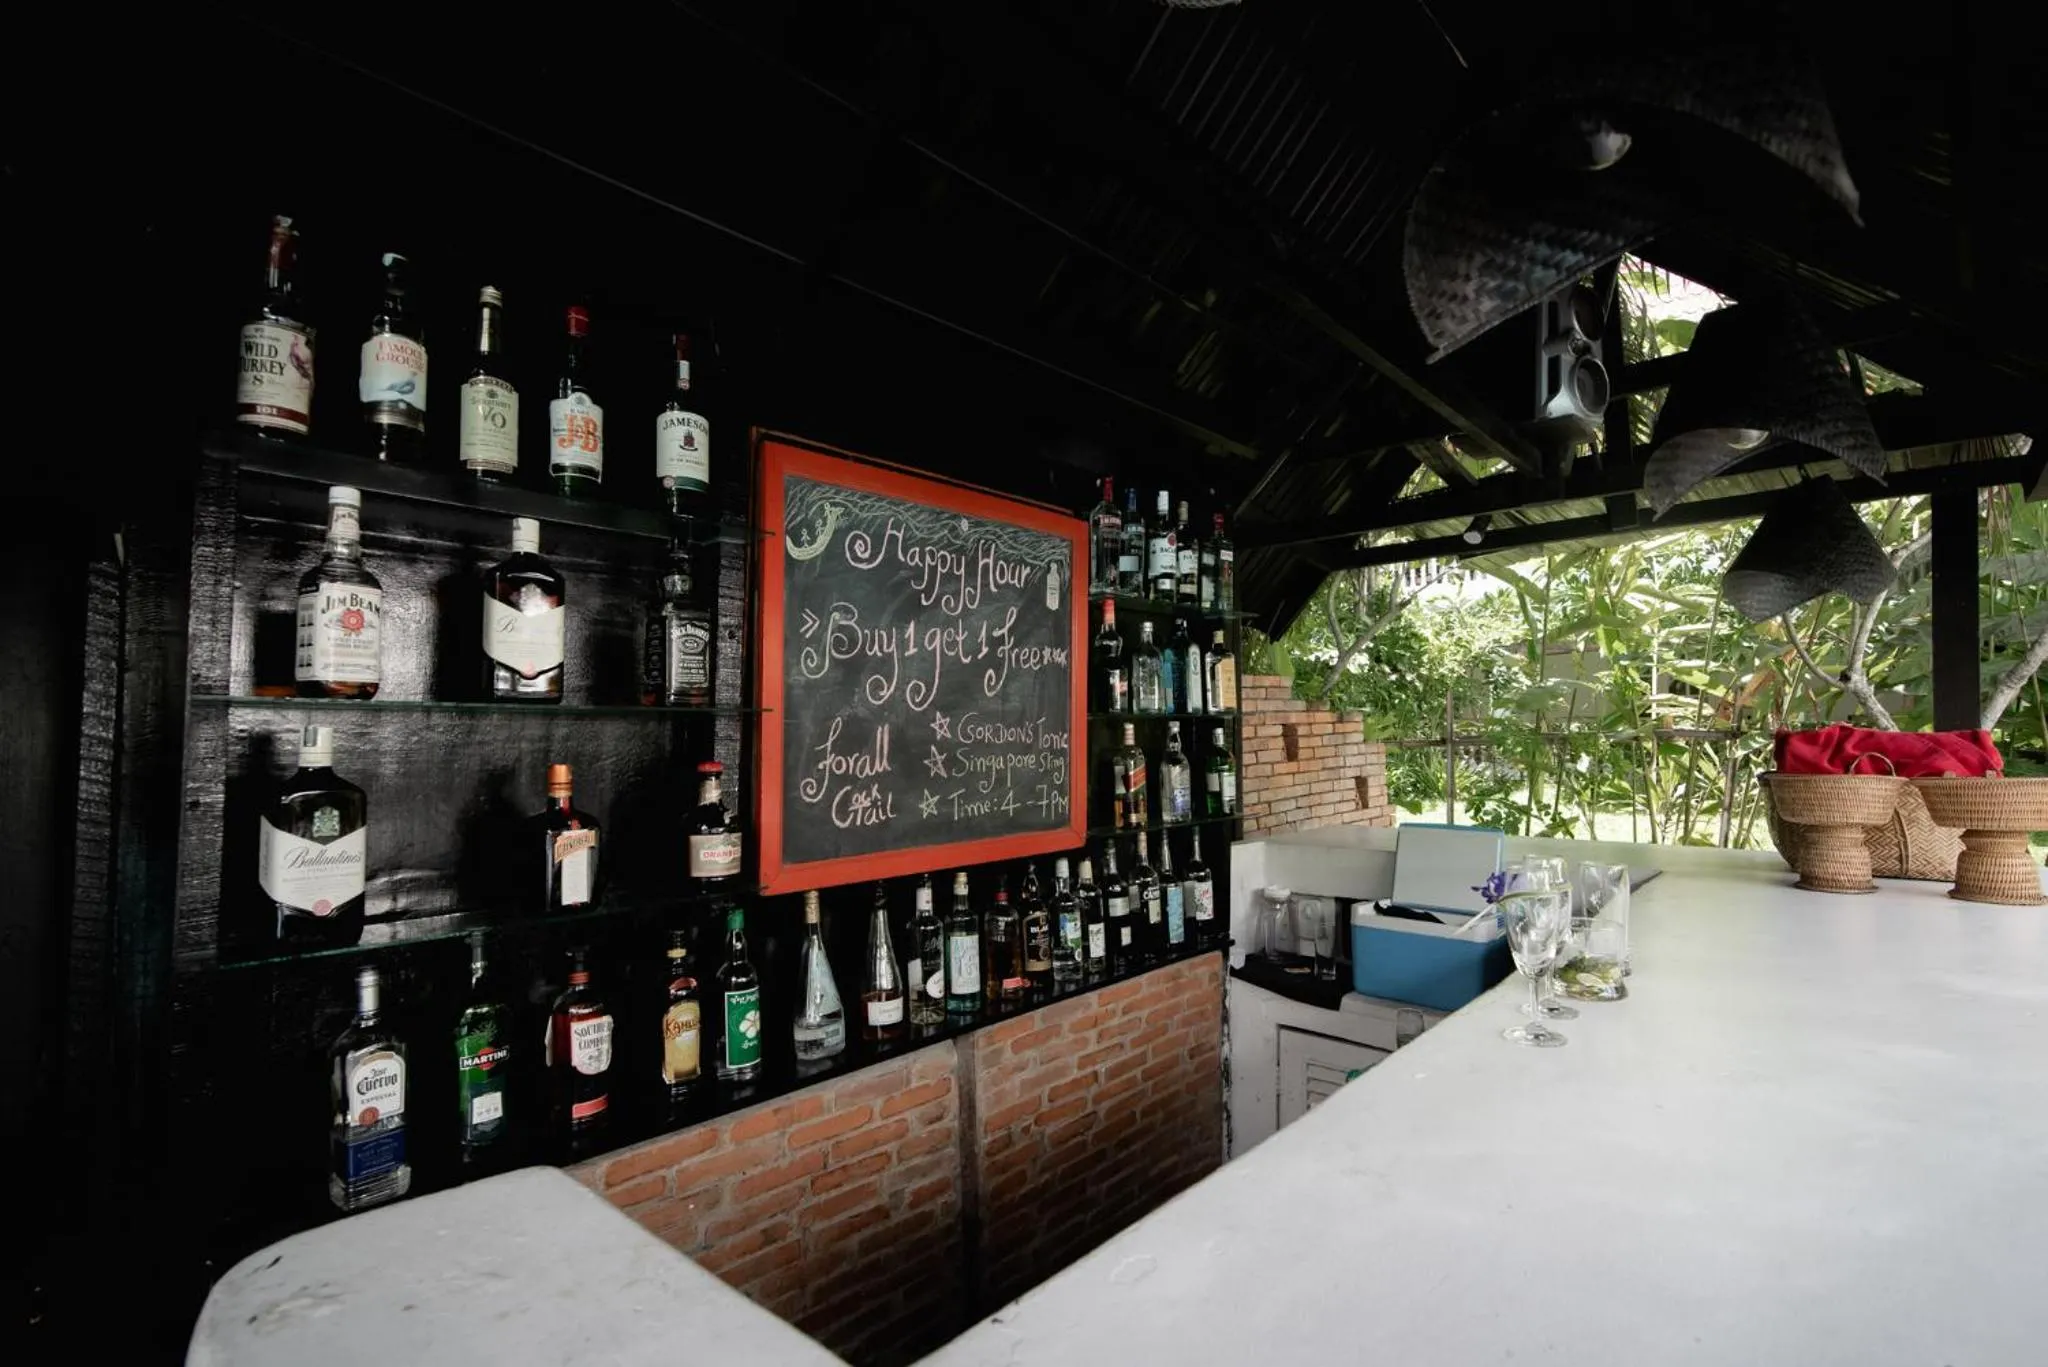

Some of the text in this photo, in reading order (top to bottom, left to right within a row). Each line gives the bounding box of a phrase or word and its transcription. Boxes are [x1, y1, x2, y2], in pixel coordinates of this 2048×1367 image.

[244, 341, 278, 359] WILD
[662, 416, 708, 436] JAMESON
[845, 517, 1031, 615] Happy Hour
[321, 595, 347, 614] JIM
[801, 602, 898, 705] Buy
[904, 620, 918, 657] 1
[977, 618, 989, 659] 1
[906, 619, 972, 711] get
[957, 712, 1069, 750] GORDON'S Tonic
[952, 747, 1036, 794] Singapore
[463, 1048, 508, 1068] MARTINI
[356, 1072, 398, 1096] Cuervo
